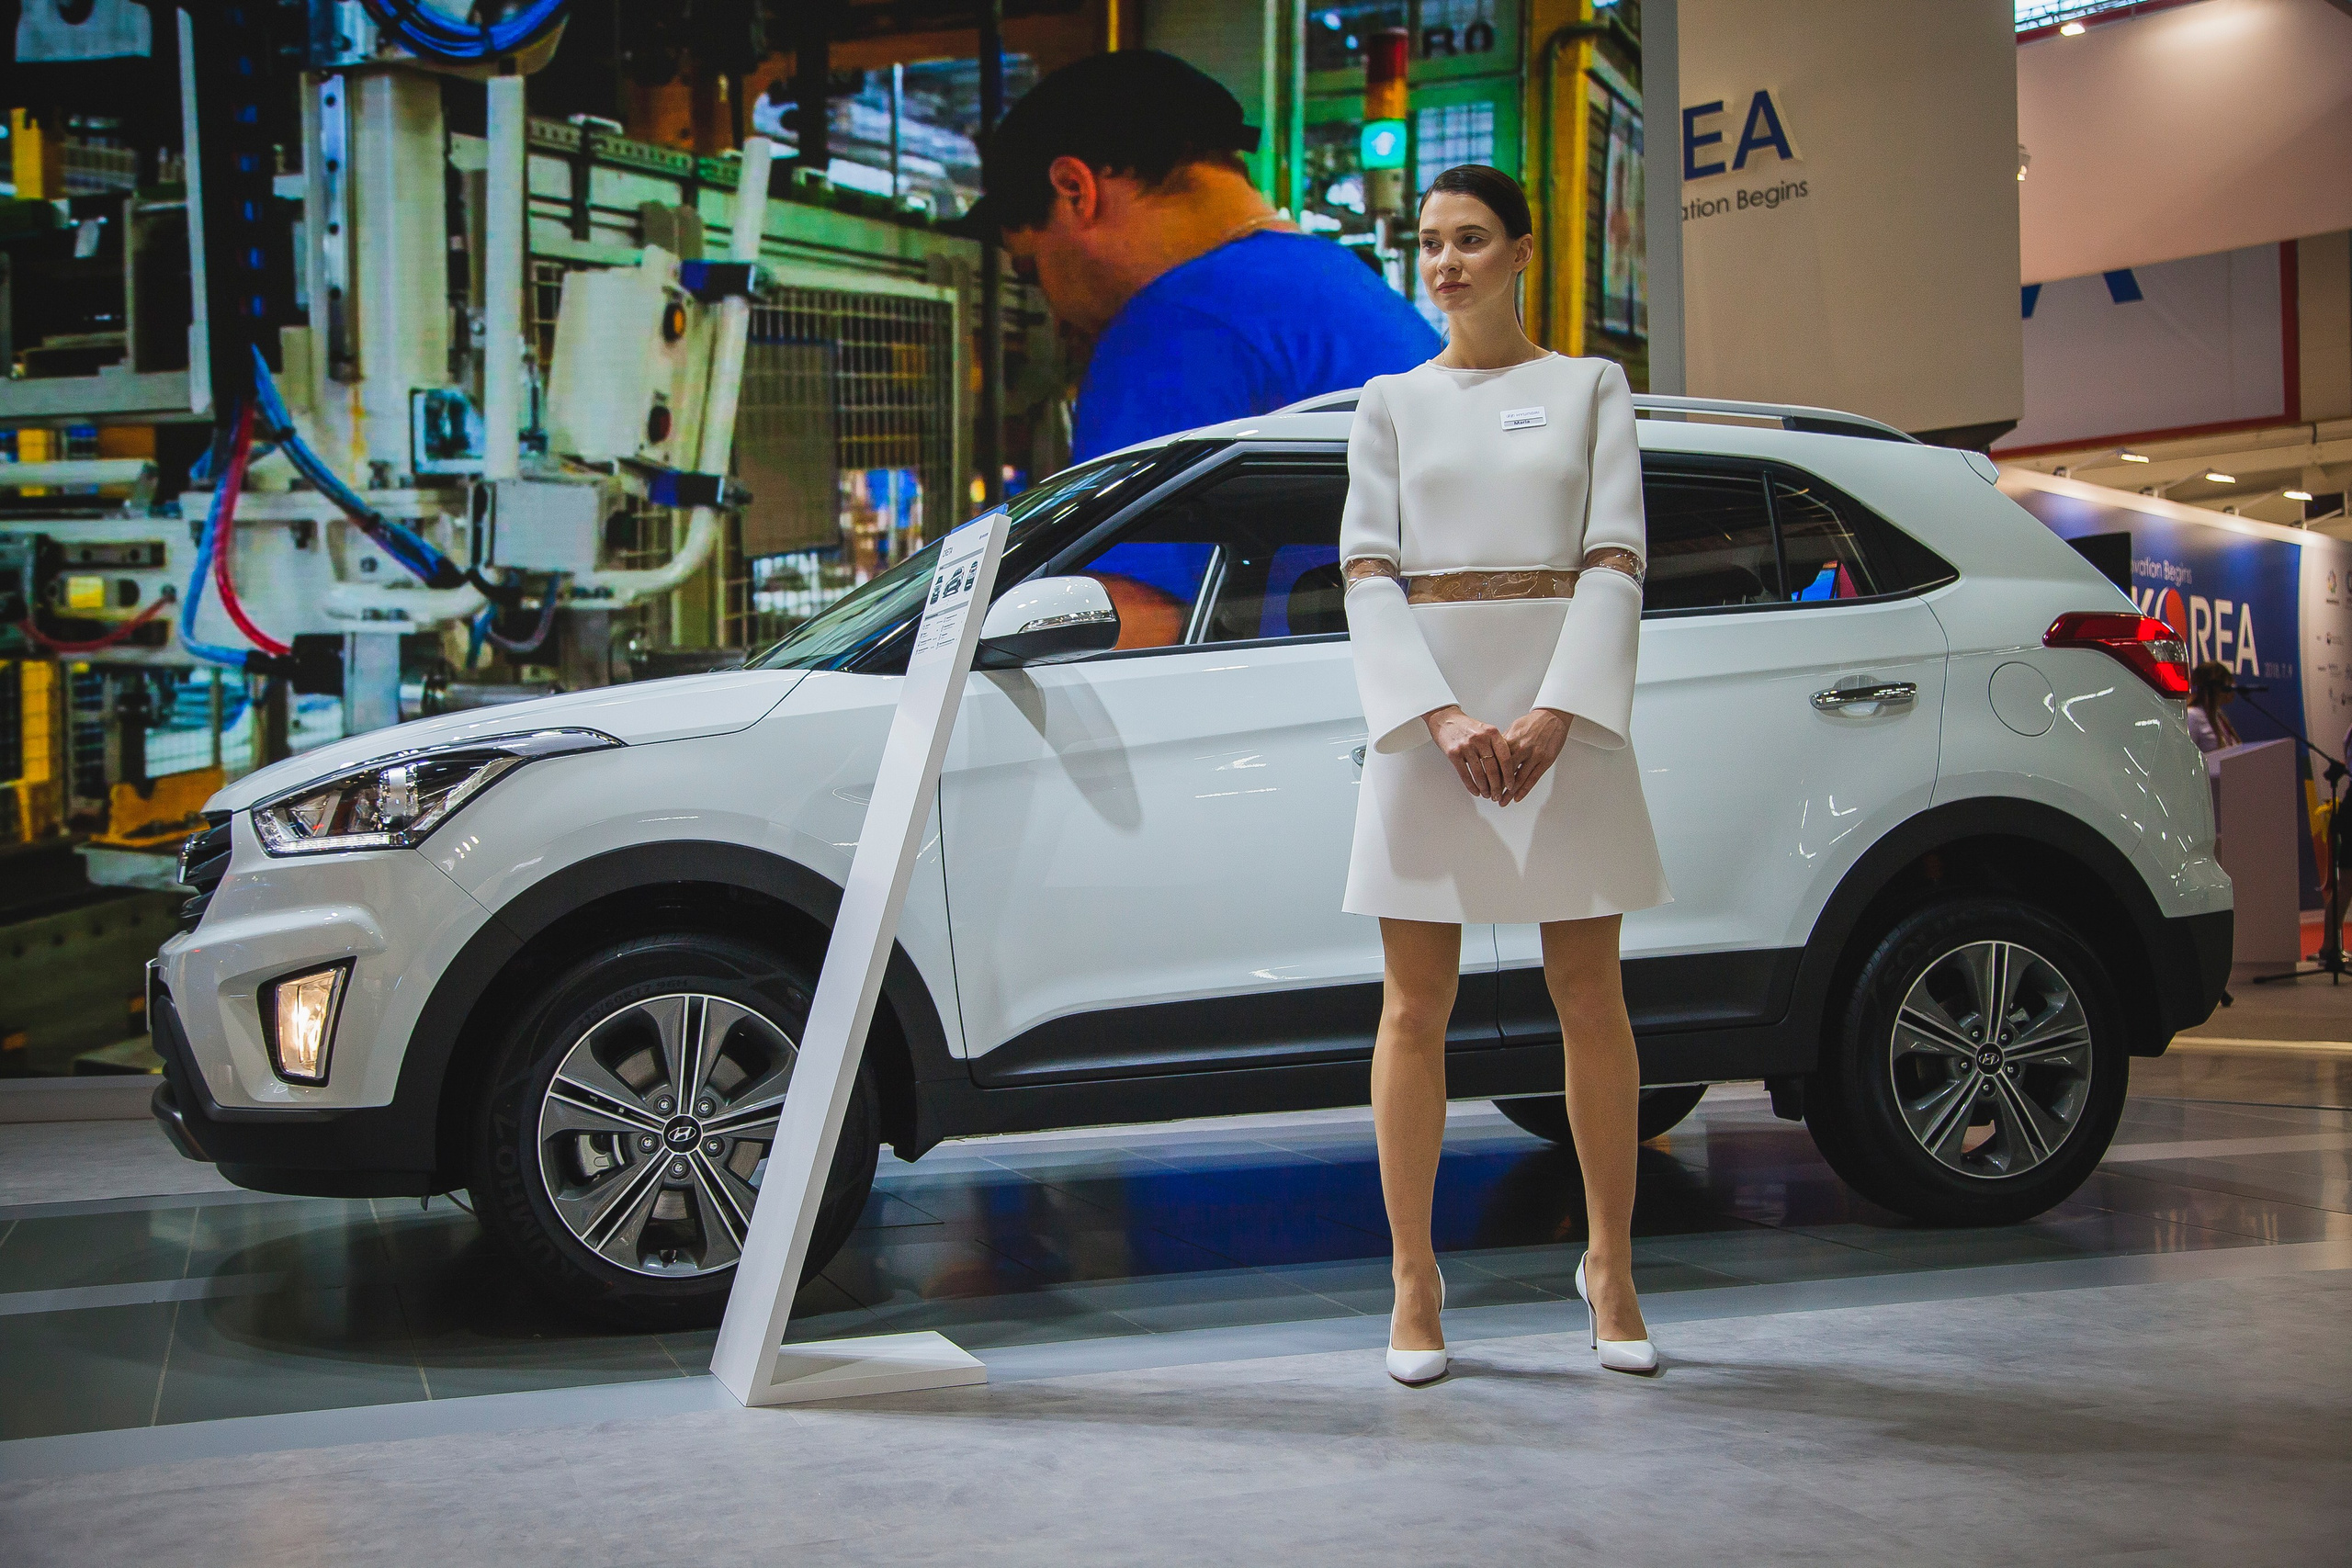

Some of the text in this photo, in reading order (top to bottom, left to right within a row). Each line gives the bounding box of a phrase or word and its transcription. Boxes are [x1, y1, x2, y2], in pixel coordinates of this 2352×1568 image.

[1682, 89, 1794, 181] EA
[1736, 179, 1808, 209] Begins
[2164, 559, 2193, 587] Begins
